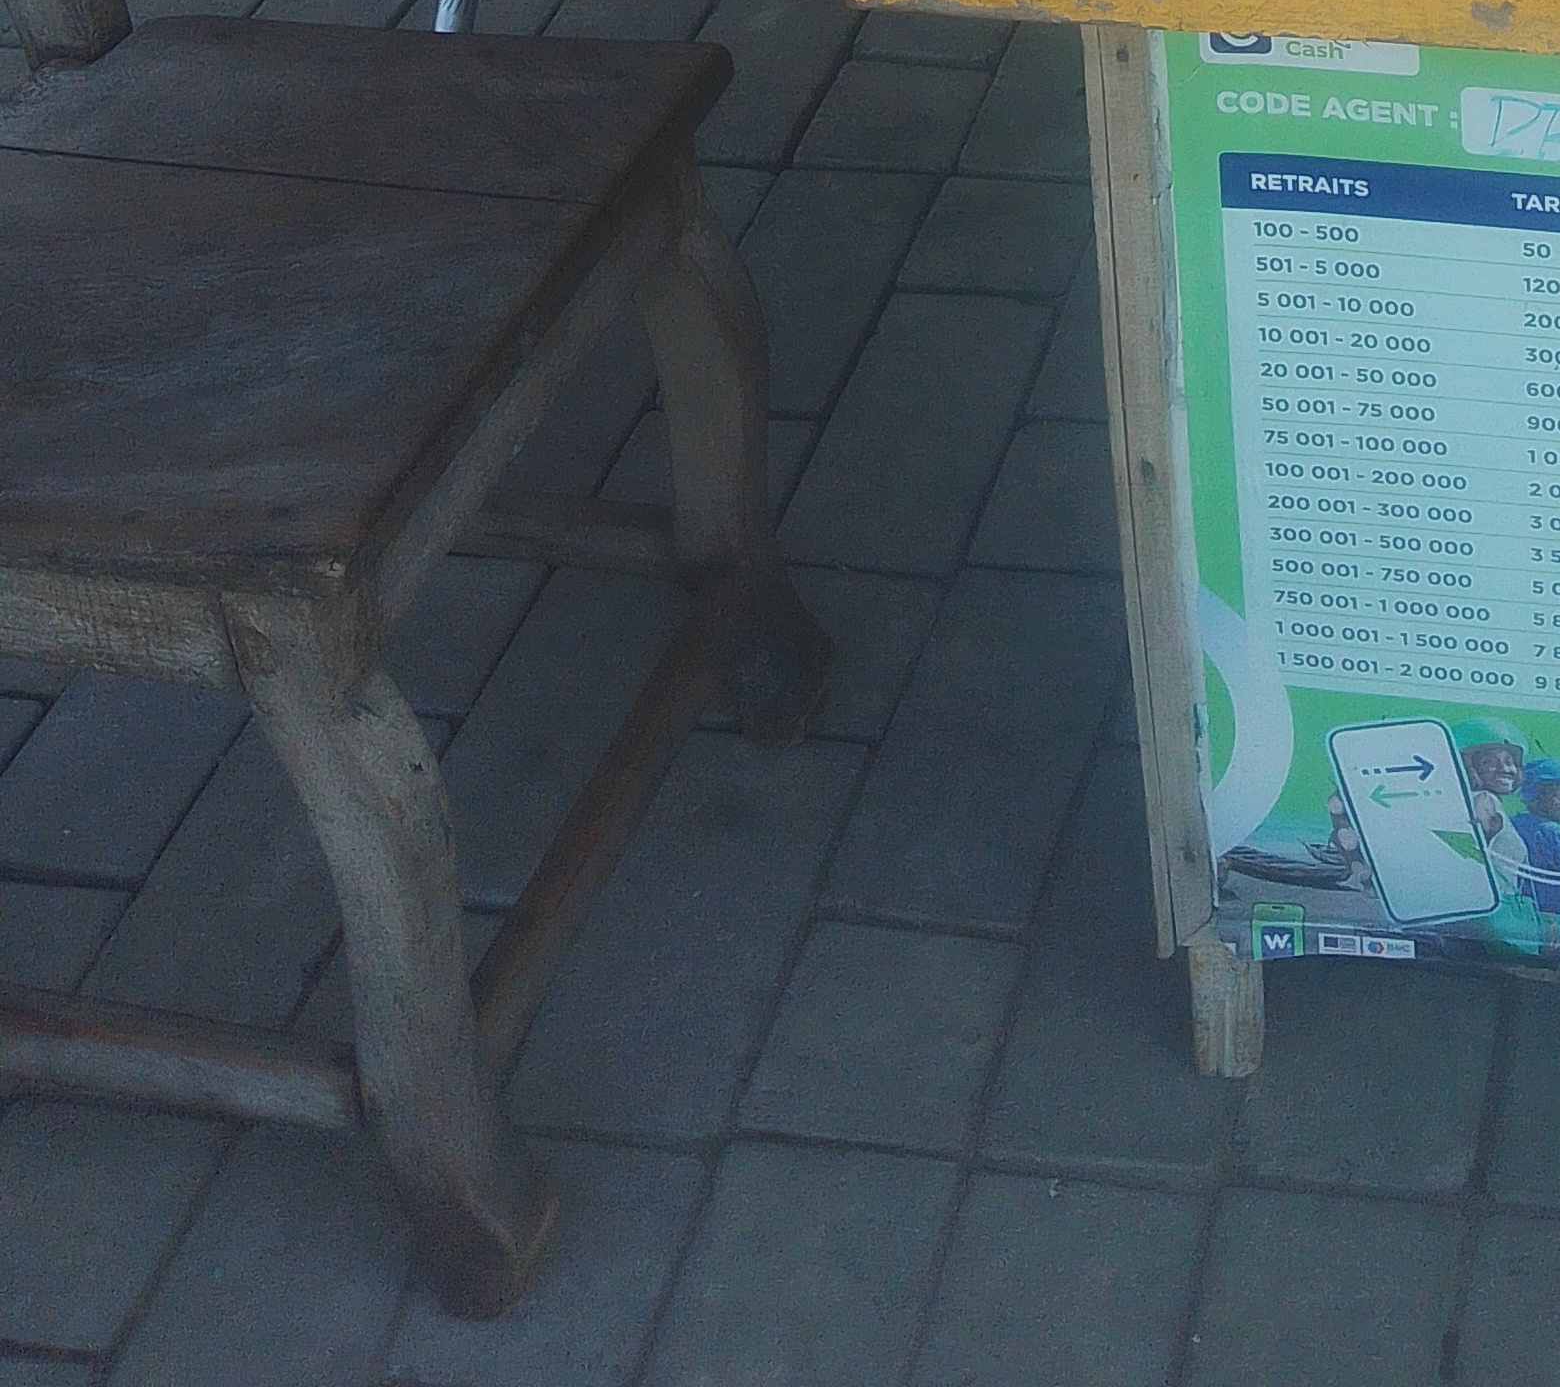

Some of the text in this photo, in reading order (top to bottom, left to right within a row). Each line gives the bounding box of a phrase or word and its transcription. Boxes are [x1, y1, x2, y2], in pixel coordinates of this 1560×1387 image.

[1284, 39, 1345, 60] Cash
[1216, 90, 1312, 117] CODE
[1322, 96, 1439, 127] AGENT
[1250, 172, 1370, 197] RETRAITS
[1253, 221, 1293, 238] 100
[1315, 225, 1359, 243] 500
[1522, 242, 1551, 259] 50
[1256, 256, 1292, 273] 501
[1315, 260, 1327, 275] 5
[1334, 261, 1380, 279] 000
[1522, 277, 1560, 295] 120
[1257, 292, 1270, 307] 5
[1277, 293, 1315, 310] 001
[1337, 297, 1362, 313] 10
[1369, 299, 1414, 317] 000
[1257, 327, 1283, 343] 10
[1289, 328, 1328, 346] 001
[1350, 333, 1378, 349] 20
[1385, 335, 1431, 353] 000
[1260, 362, 1288, 378] 20
[1295, 364, 1334, 381] 001
[1356, 368, 1384, 384] 50
[1391, 371, 1437, 388] 000
[1262, 397, 1290, 413] 50
[1296, 399, 1335, 415] 001
[1357, 402, 1383, 418] 75
[1389, 405, 1435, 422] 000
[1263, 429, 1289, 445] 75
[1295, 432, 1334, 449] 001
[1355, 435, 1395, 452] 100
[1402, 439, 1448, 456] 000
[1527, 449, 1536, 464] 1
[1265, 462, 1304, 478] 100
[1311, 465, 1350, 481] 001
[1371, 470, 1415, 486] 200
[1421, 474, 1467, 490] 000
[1529, 483, 1543, 497] 2
[1267, 495, 1311, 511] 200
[1317, 498, 1355, 515] 001
[1377, 502, 1420, 519] 300
[1427, 507, 1473, 523] 000
[1530, 515, 1543, 529] 3
[1269, 527, 1312, 543] 300
[1319, 530, 1357, 547] 001
[1379, 535, 1422, 551] 500
[1428, 539, 1474, 556] 000
[1530, 547, 1544, 562] 3
[1272, 558, 1314, 575] 500
[1321, 562, 1359, 579] 001
[1380, 567, 1421, 583] 750
[1427, 572, 1472, 588] 000
[1532, 580, 1544, 595] 5
[1273, 589, 1313, 606] 750
[1320, 594, 1358, 610] 001
[1378, 599, 1387, 613] 1
[1394, 600, 1439, 617] 000
[1445, 605, 1490, 621] 000
[1533, 612, 1545, 626] 5
[1275, 620, 1284, 634] 1
[1291, 622, 1335, 639] 000
[1341, 627, 1379, 643] 001
[1400, 632, 1408, 646] 1
[1416, 633, 1458, 650] 500
[1464, 638, 1509, 655] 000
[1533, 644, 1546, 658] 7
[1277, 651, 1286, 665] 1
[1292, 652, 1334, 670] 500
[1341, 658, 1379, 674] 001
[1399, 663, 1413, 677] 2
[1418, 665, 1463, 682] 000
[1470, 670, 1515, 687] 000
[1534, 676, 1547, 689] 9
